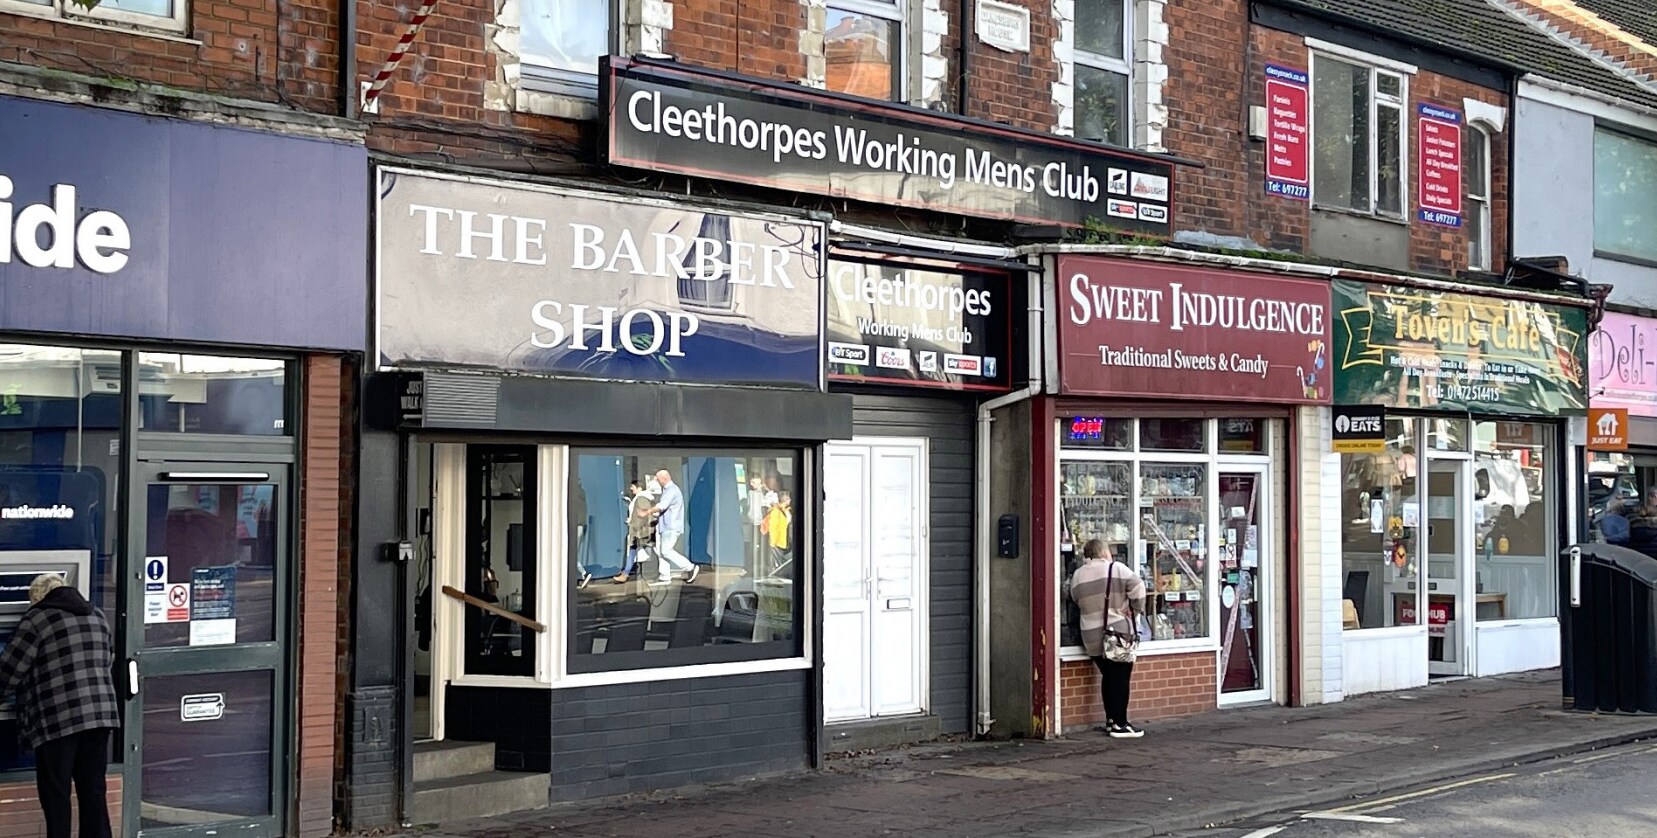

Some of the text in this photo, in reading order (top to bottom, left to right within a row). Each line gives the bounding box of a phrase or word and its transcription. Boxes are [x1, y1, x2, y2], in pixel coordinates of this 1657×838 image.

[628, 90, 1099, 203] Cleethorpes Working Mens Club
[1282, 183, 1307, 197] 697277
[0, 174, 131, 274] ide
[409, 203, 795, 290] THE BARBER
[835, 264, 992, 321] Cleethorpes
[1070, 273, 1325, 336] SWEET INDULGENCE
[530, 299, 699, 357] SHOP
[857, 317, 972, 344] Working Mens Club
[1391, 304, 1480, 346] Toven's
[845, 347, 864, 359] Sport
[881, 351, 905, 367] Coors
[1099, 345, 1269, 379] Traditional Sweets & Candy
[1592, 324, 1657, 385] Deli-
[1426, 385, 1443, 398] Tel:
[1071, 420, 1103, 433] OPEN
[1350, 420, 1382, 432] EATS
[1591, 437, 1623, 446] JUST EAT
[1, 504, 74, 519] nationwide
[1402, 608, 1446, 619] FOHUB
